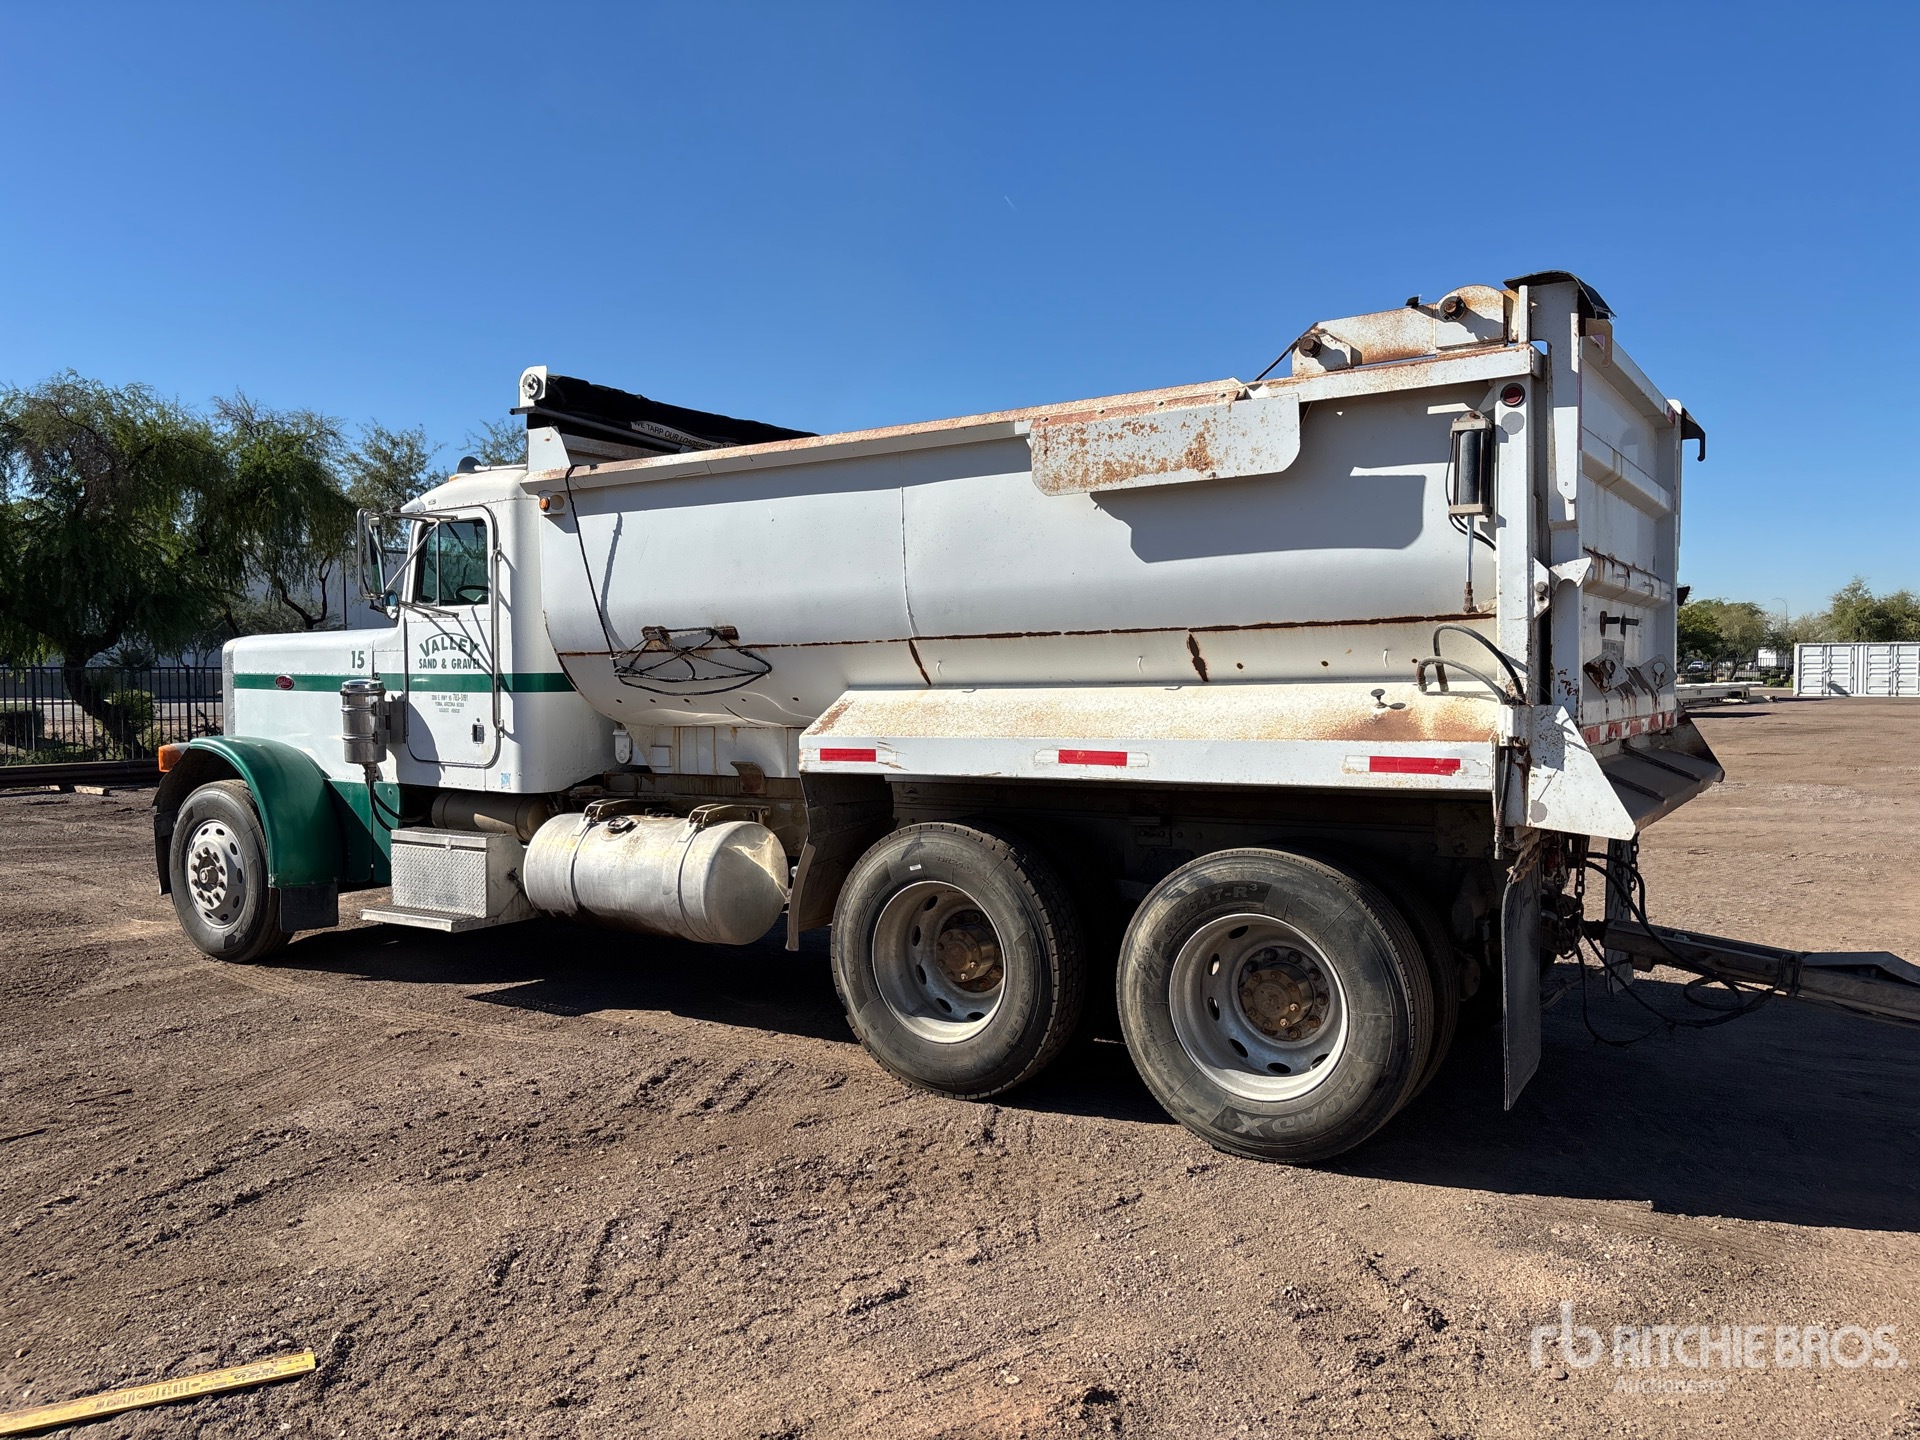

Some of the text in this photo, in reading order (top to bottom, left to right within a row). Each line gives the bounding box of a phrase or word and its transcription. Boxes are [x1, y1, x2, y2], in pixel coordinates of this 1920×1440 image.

[646, 423, 664, 435] TARP
[664, 430, 680, 440] OUR
[418, 636, 481, 658] VALLEY
[351, 650, 365, 669] 15
[418, 658, 481, 670] SAND & GRAVEL
[1234, 1073, 1366, 1138] ROADX
